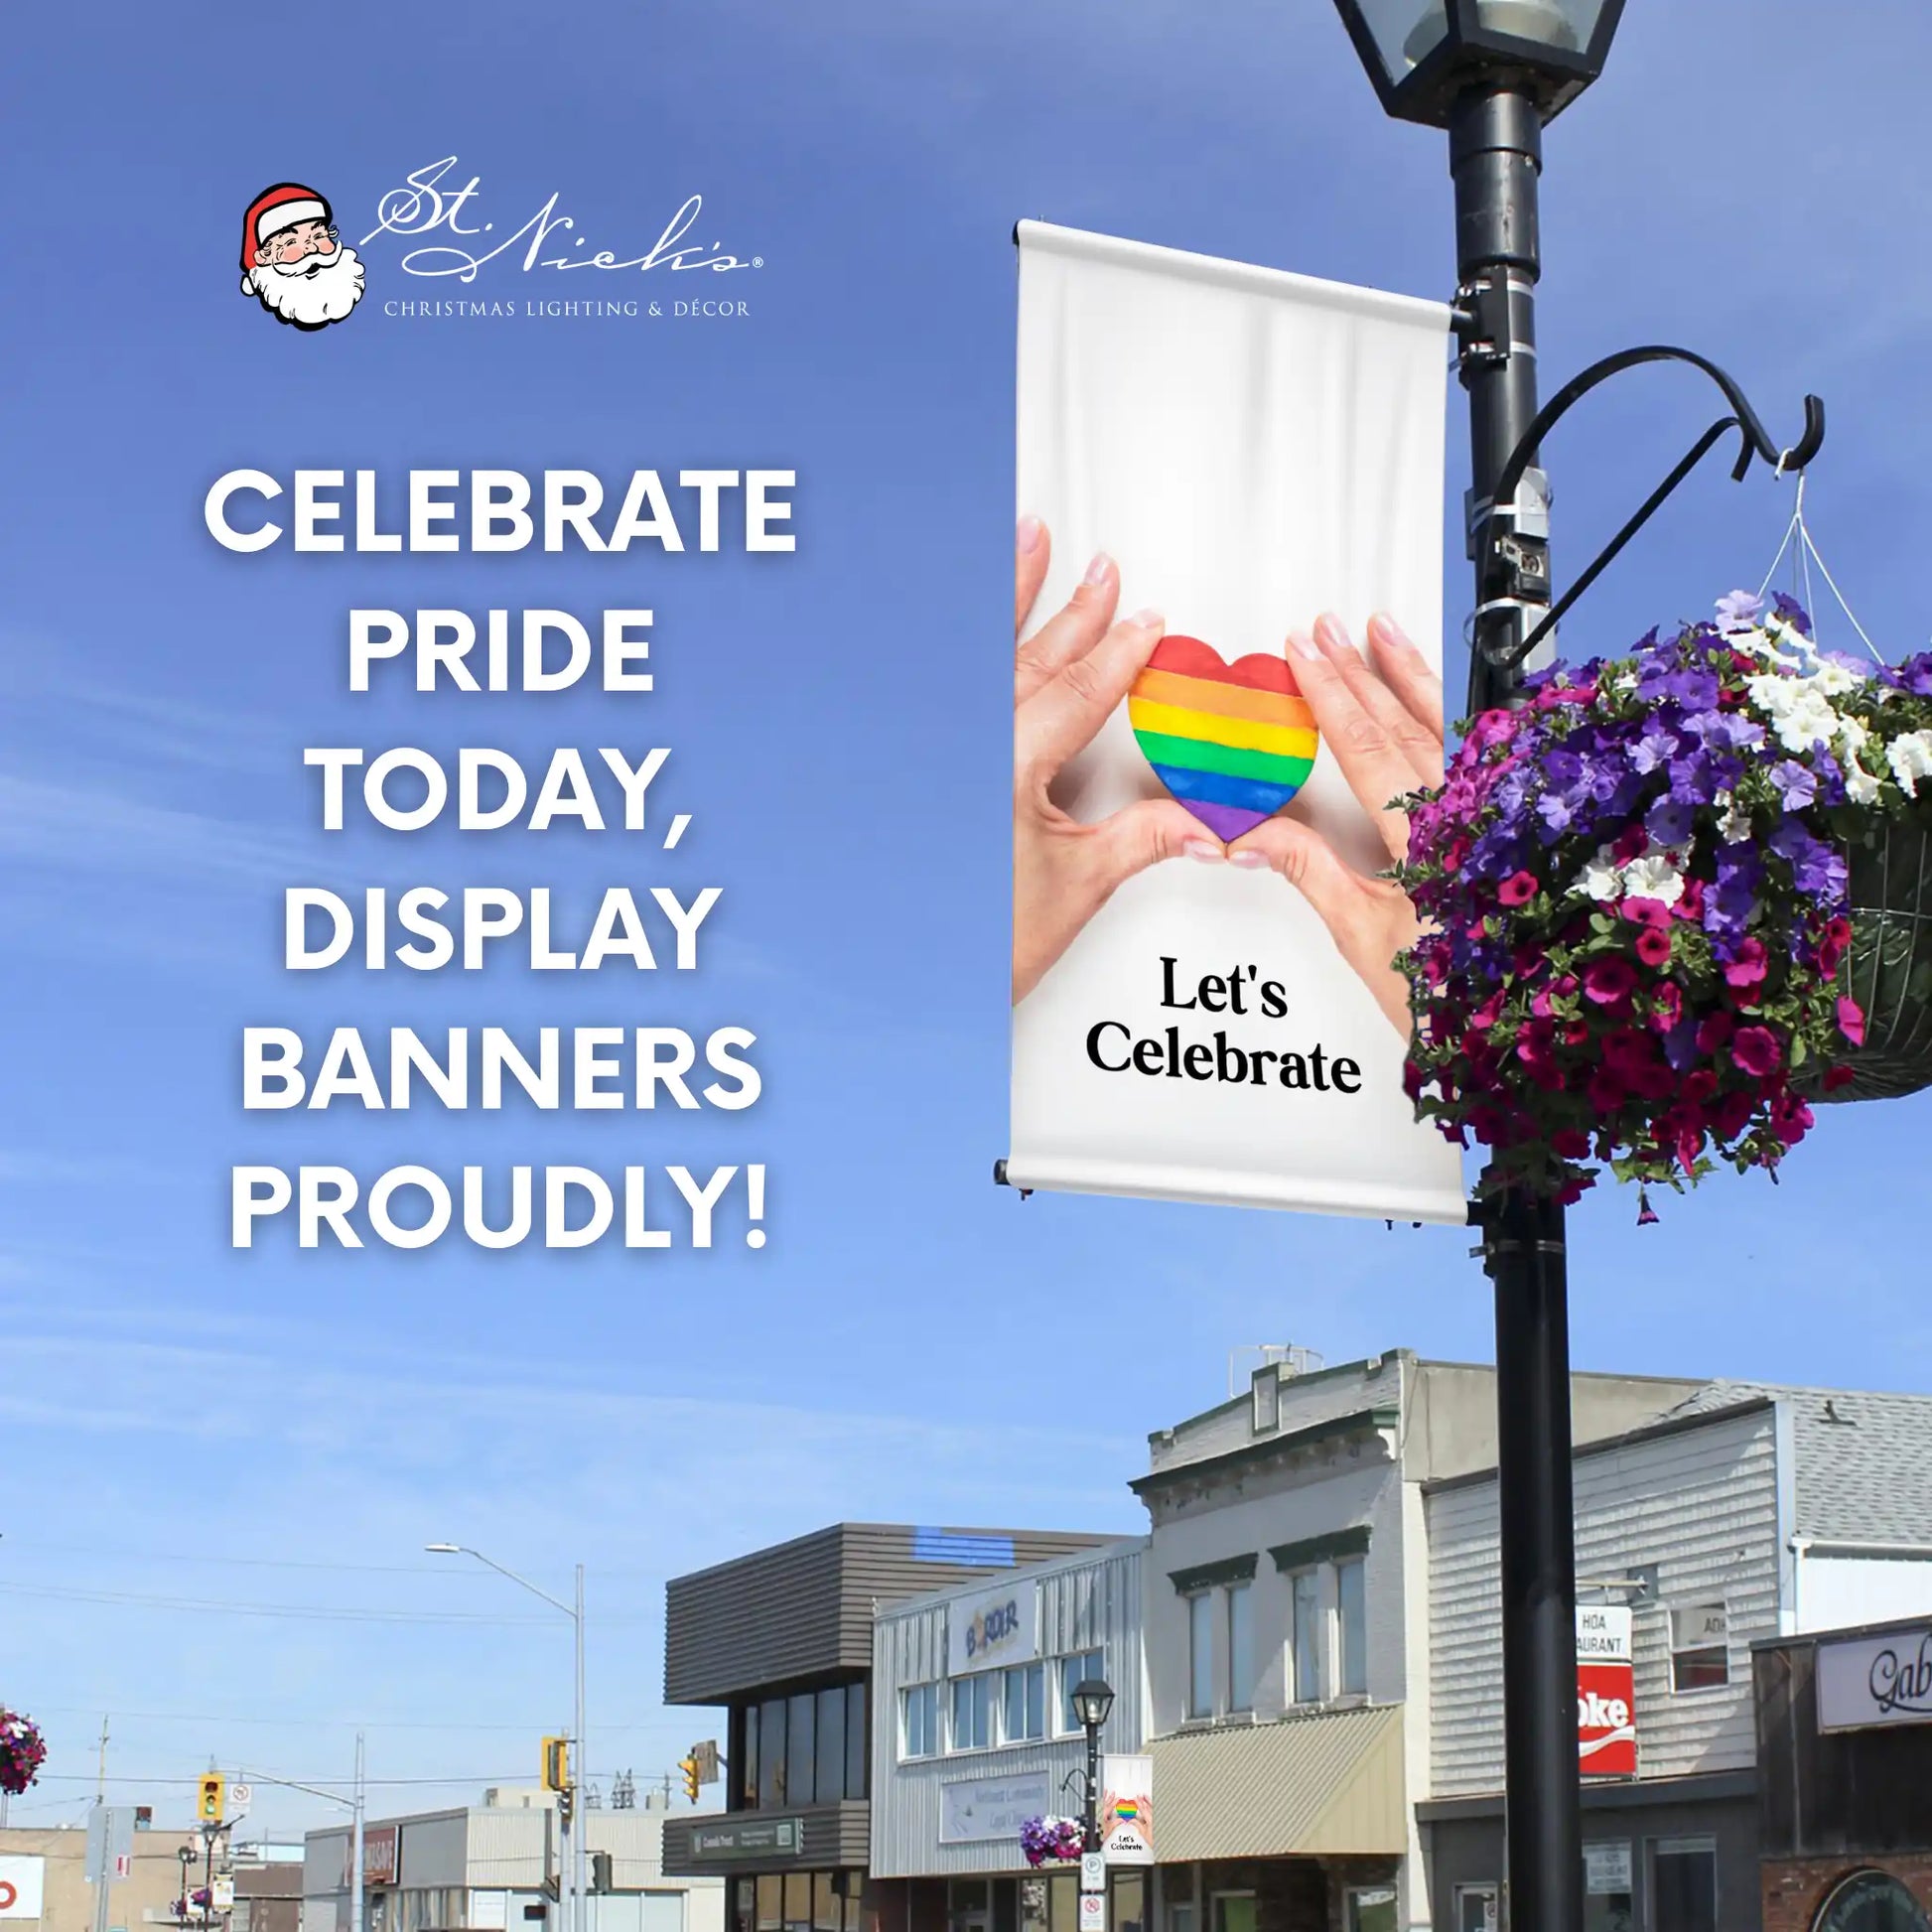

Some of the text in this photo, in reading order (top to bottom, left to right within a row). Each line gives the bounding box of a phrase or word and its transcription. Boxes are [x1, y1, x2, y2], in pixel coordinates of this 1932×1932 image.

[1160, 956, 1289, 1019] Let's
[1086, 1021, 1362, 1094] Celebrate
[1583, 1614, 1606, 1629] HOA
